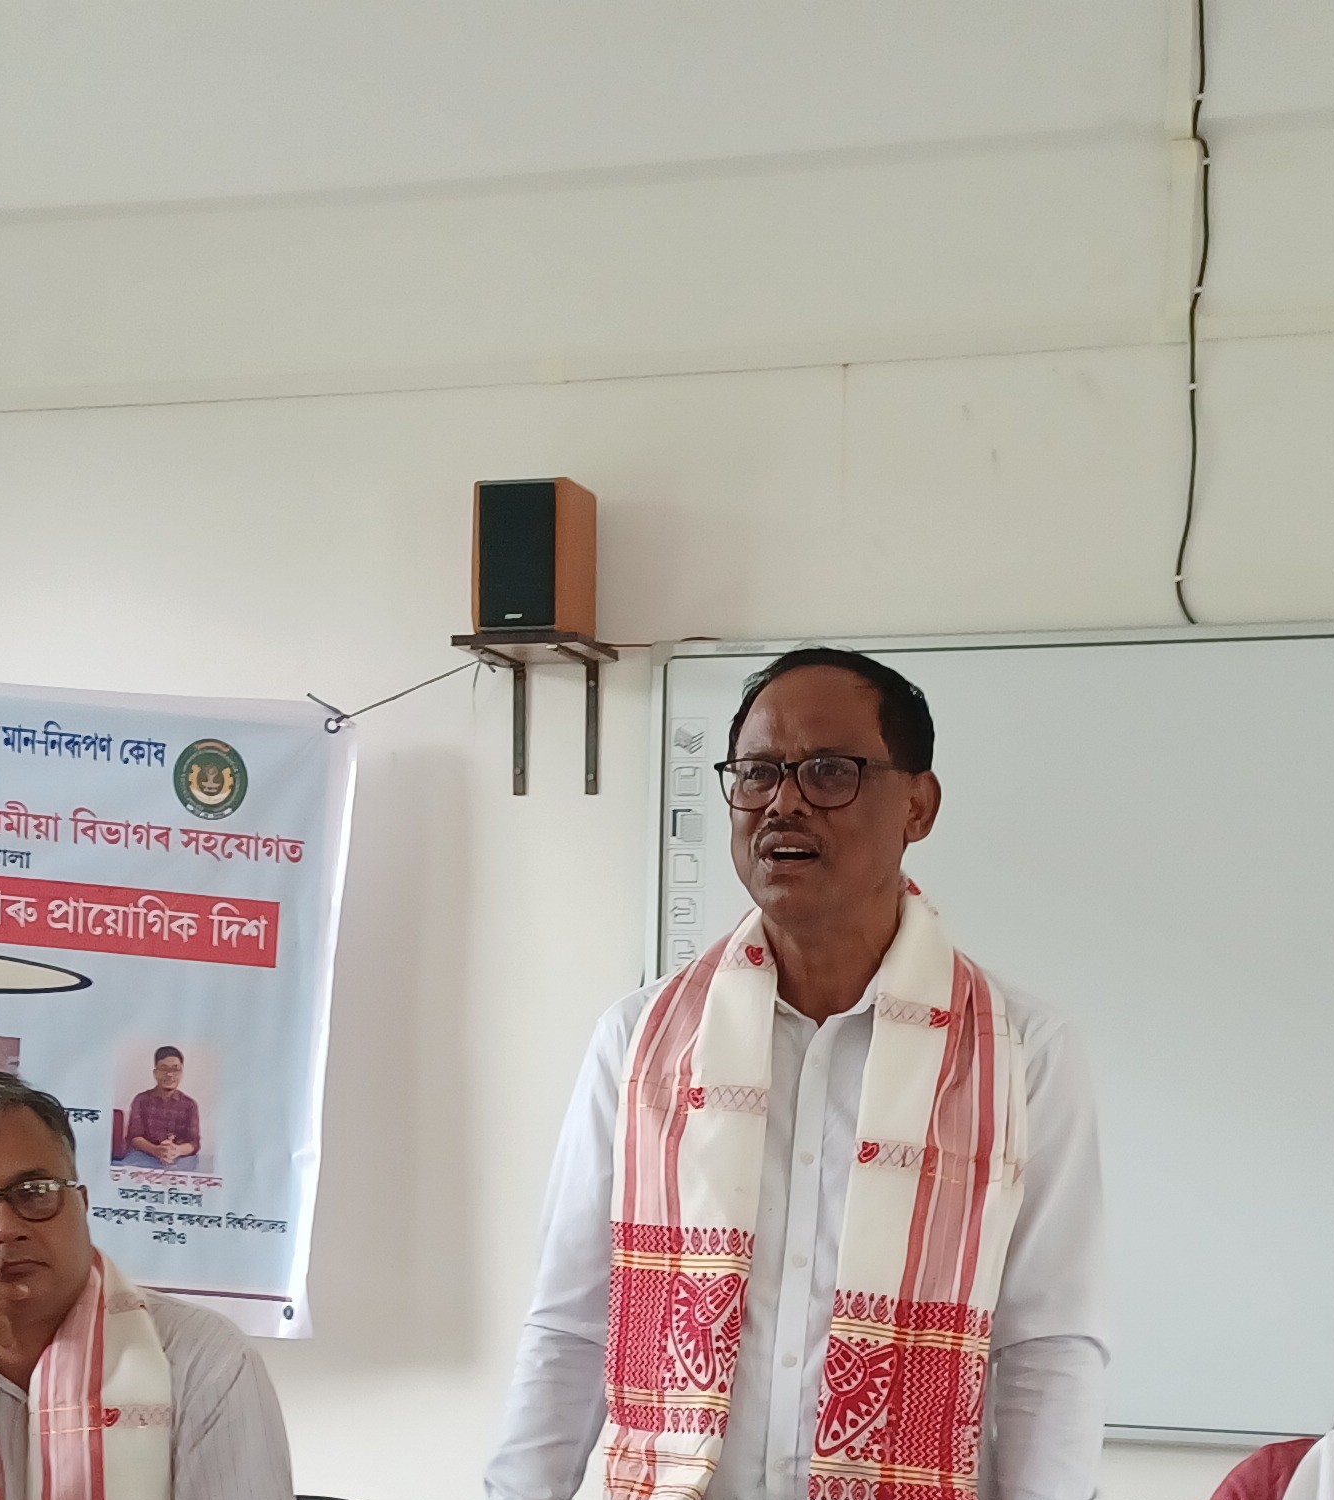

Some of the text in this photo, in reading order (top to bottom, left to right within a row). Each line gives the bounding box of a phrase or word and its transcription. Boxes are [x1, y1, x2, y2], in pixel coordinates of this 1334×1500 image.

[120, 738, 167, 767] কোষ
[180, 827, 305, 864] সহযোগত
[207, 902, 268, 950] দিশ
